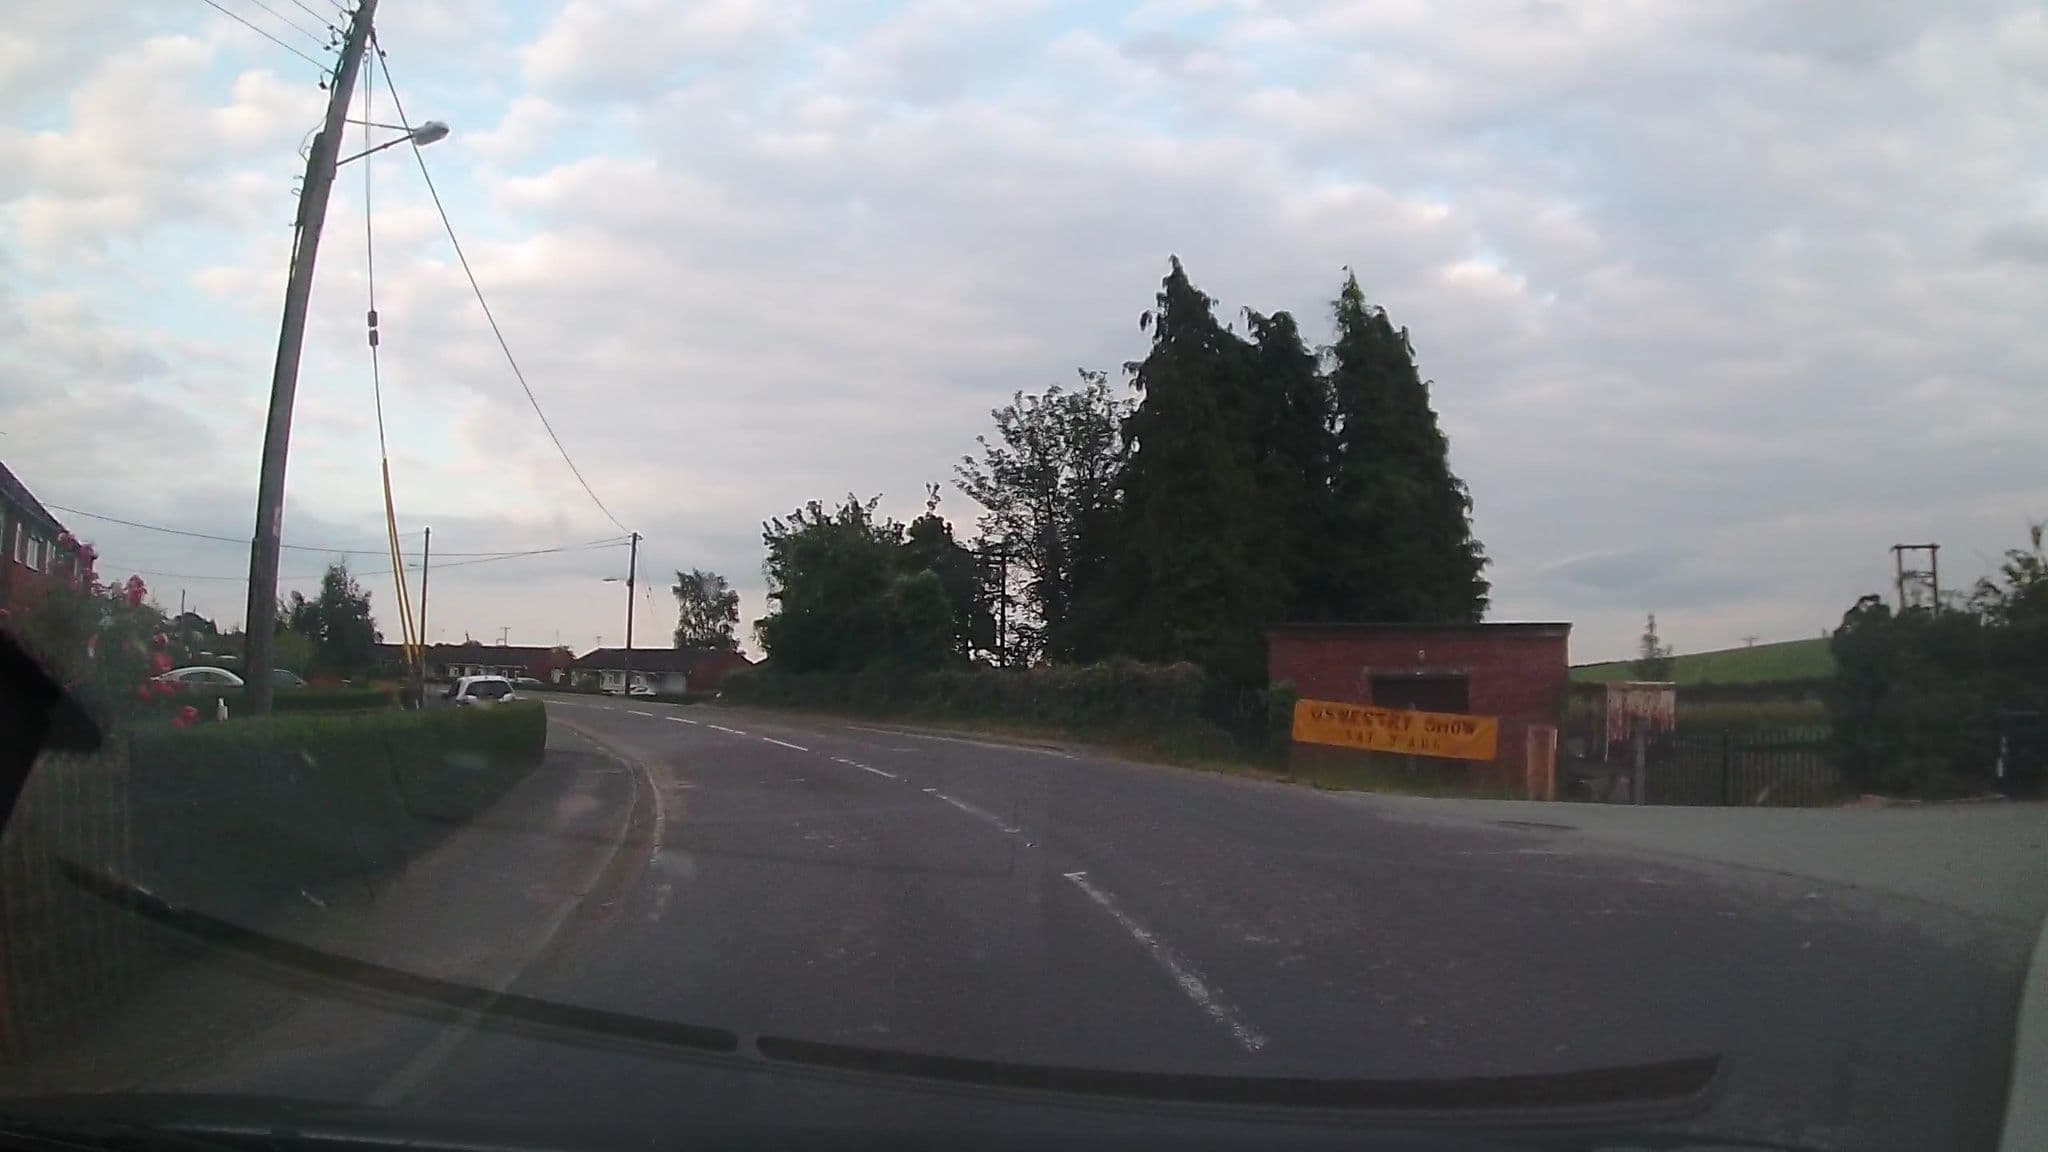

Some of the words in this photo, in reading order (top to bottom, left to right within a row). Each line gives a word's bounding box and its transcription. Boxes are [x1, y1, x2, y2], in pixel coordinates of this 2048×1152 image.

[1311, 706, 1411, 731] OSWESTRY
[1424, 717, 1477, 736] SHOW
[1345, 729, 1375, 744] SAT
